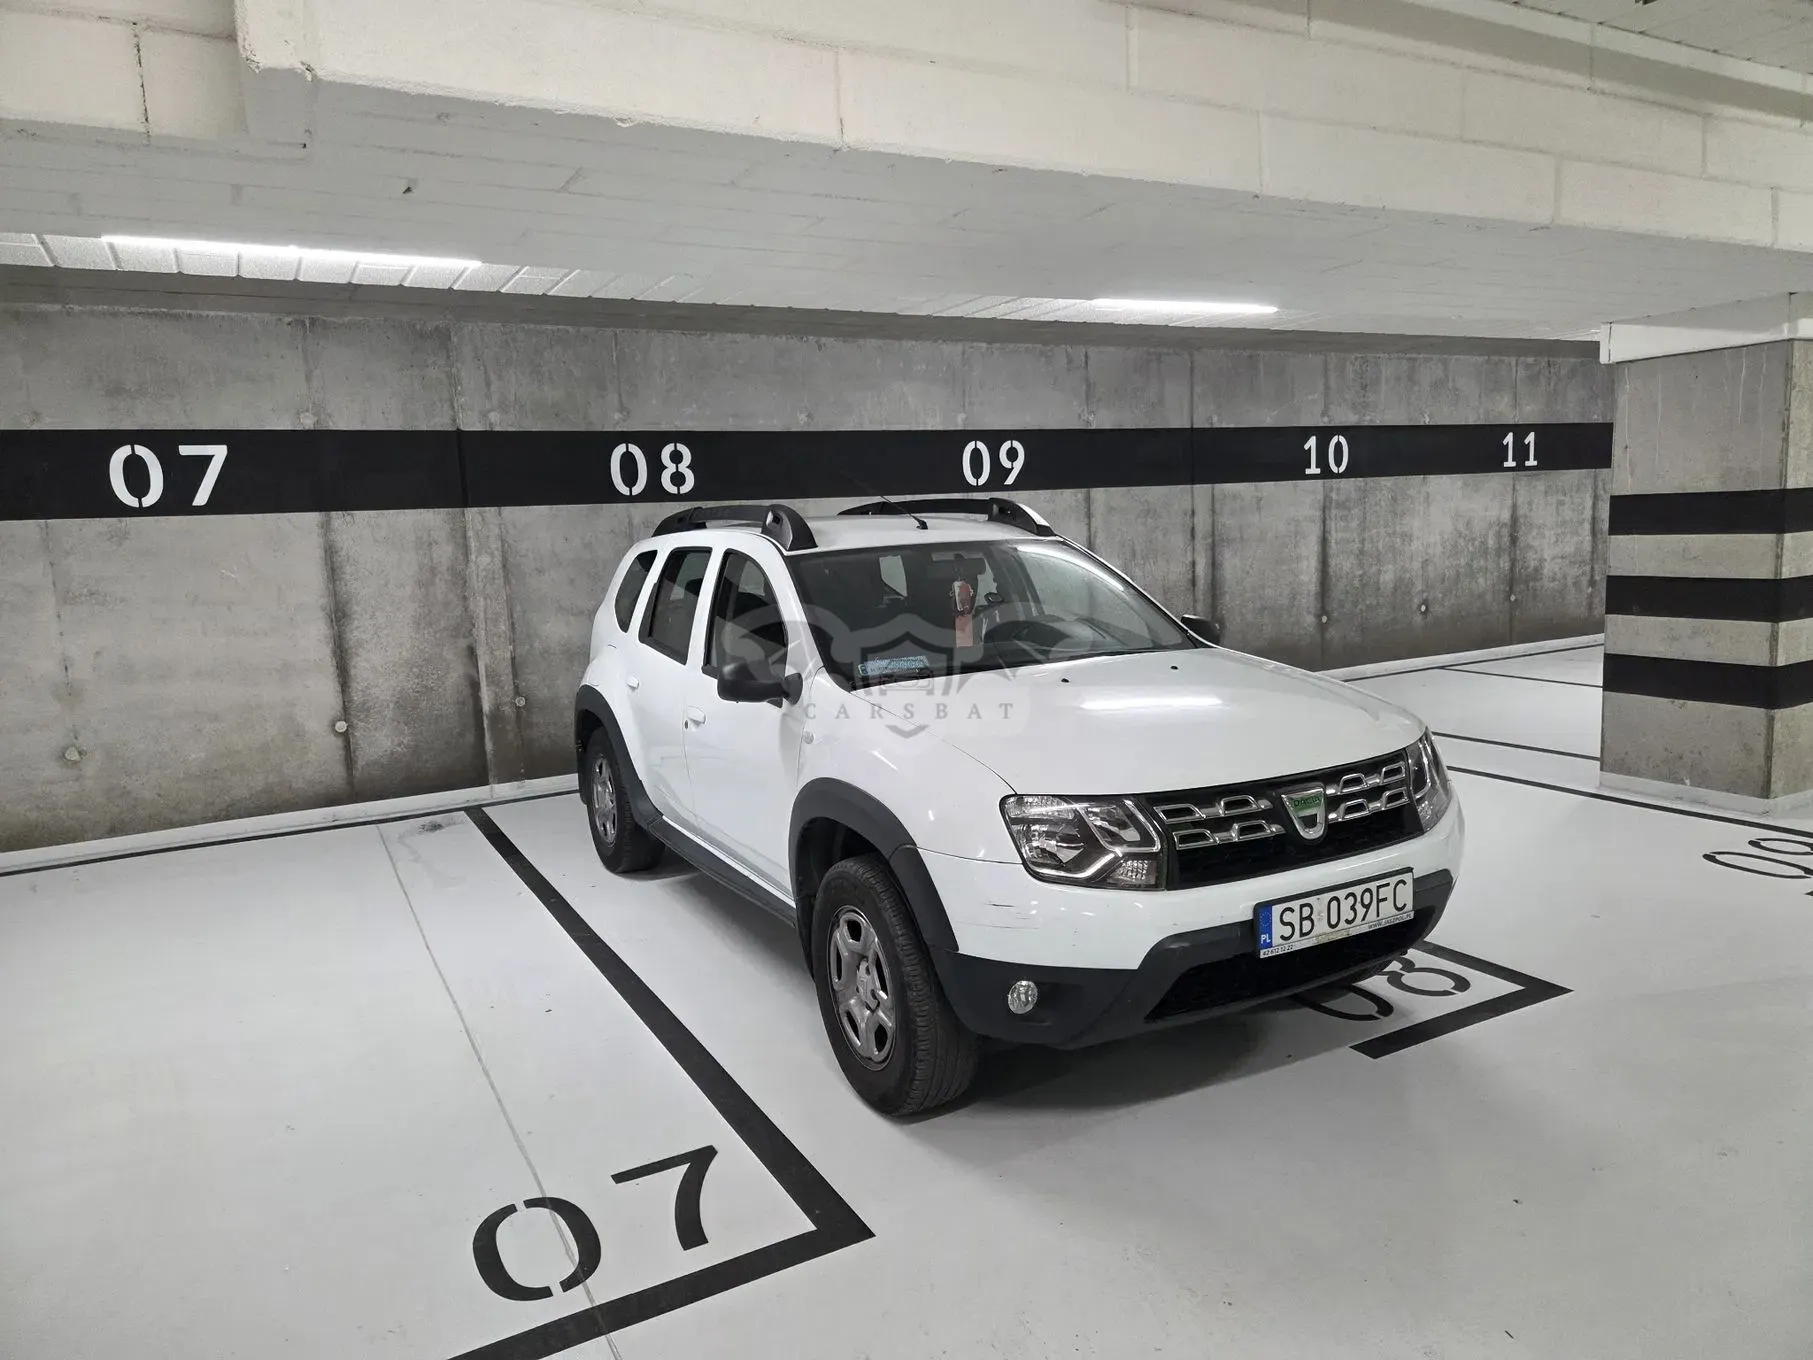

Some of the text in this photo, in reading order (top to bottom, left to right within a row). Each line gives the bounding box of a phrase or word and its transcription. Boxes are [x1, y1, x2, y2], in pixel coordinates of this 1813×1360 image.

[610, 442, 695, 496] 08
[962, 440, 1025, 486] 09
[1304, 435, 1349, 474] 10
[1502, 431, 1538, 468] 11
[109, 444, 228, 508] 07
[1279, 878, 1408, 942] SB 039FC
[1260, 933, 1271, 944] PL
[472, 1144, 719, 1302] 07
